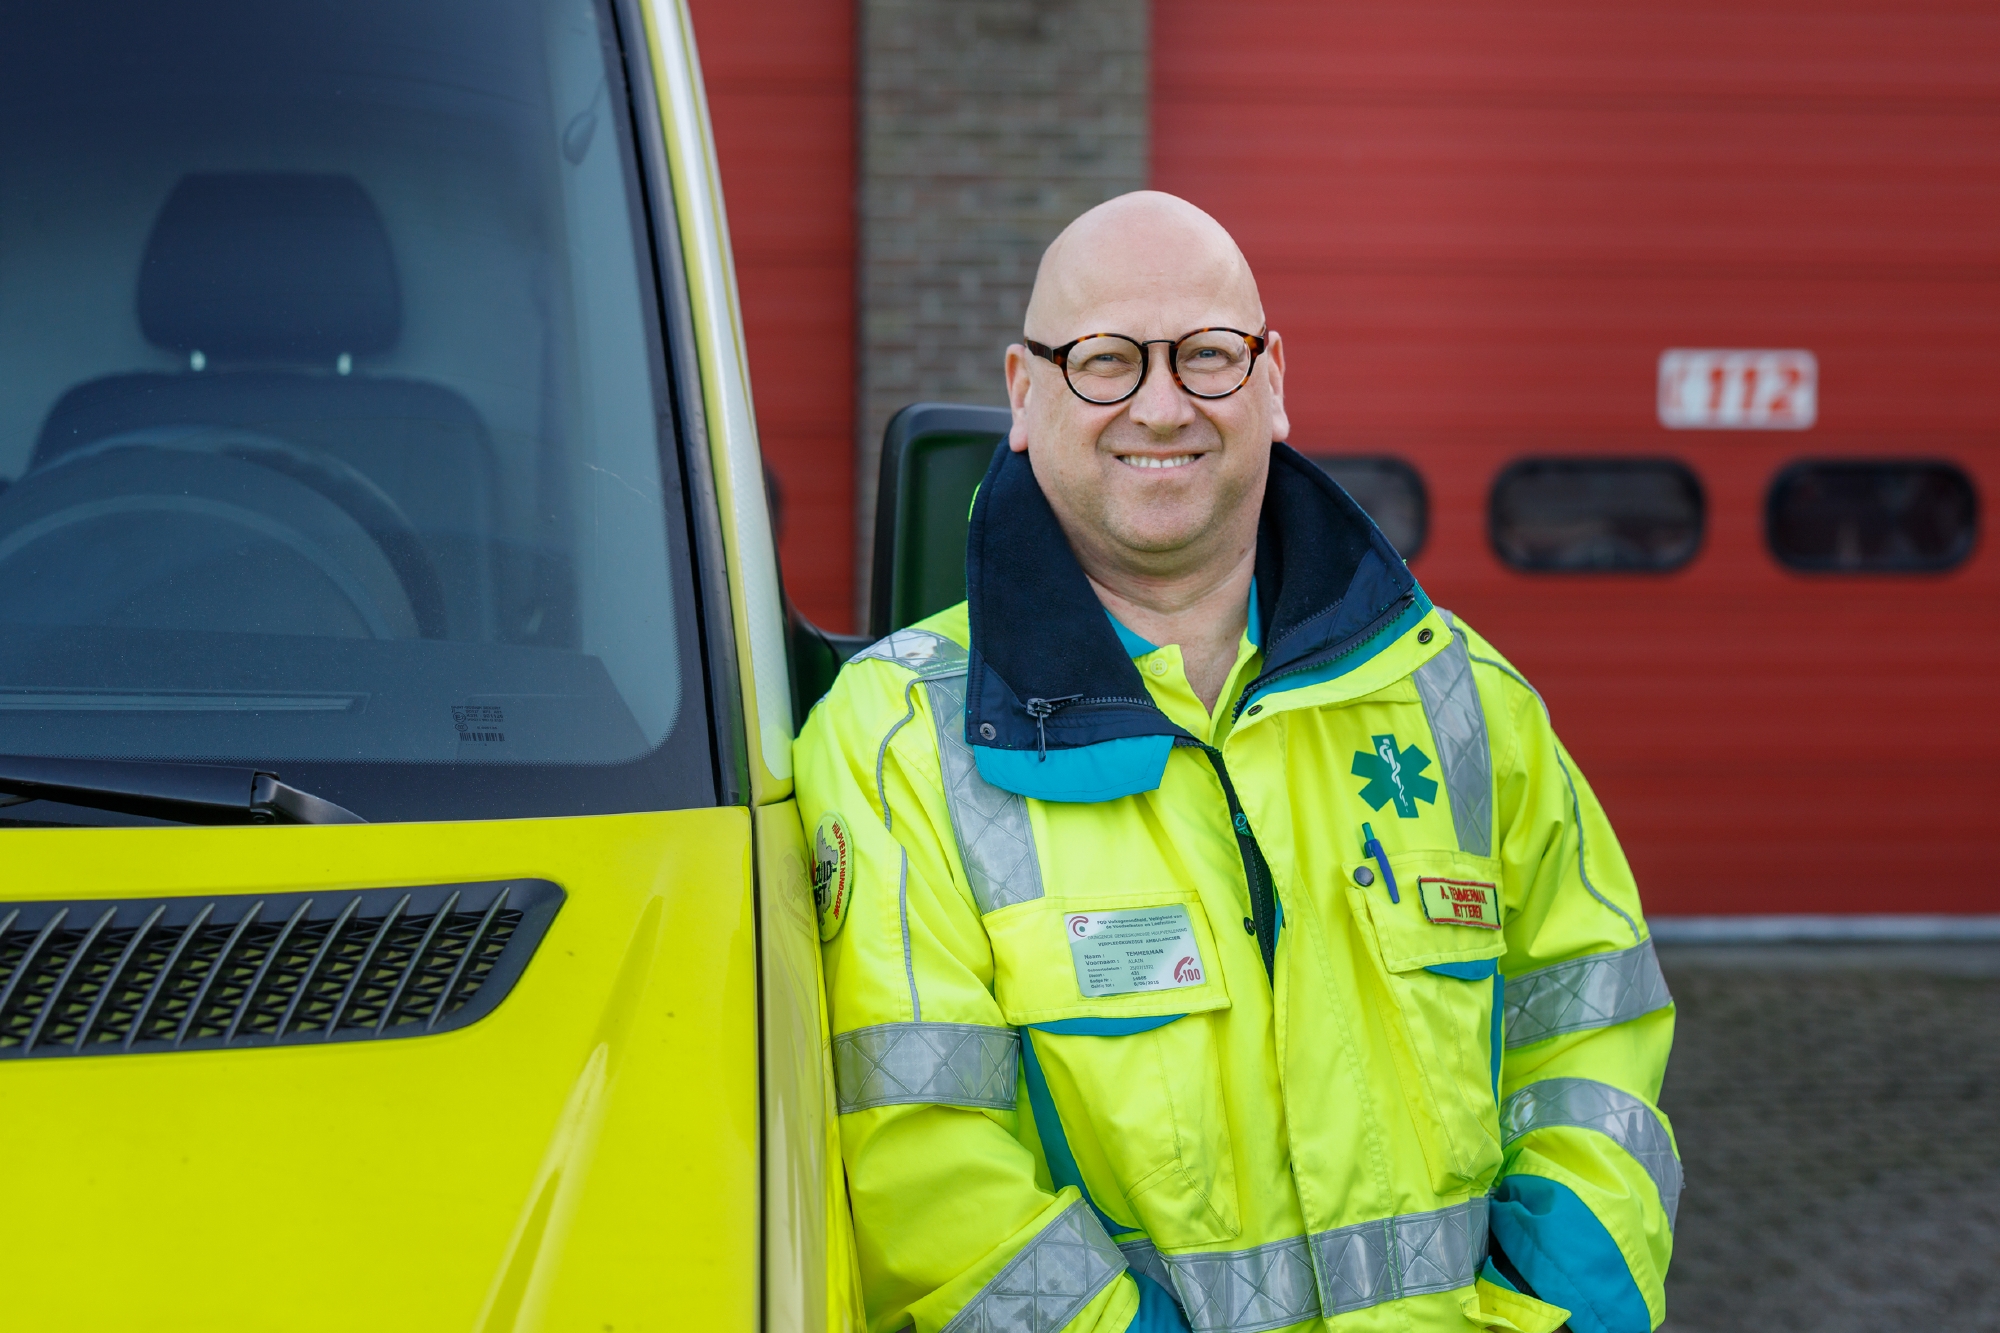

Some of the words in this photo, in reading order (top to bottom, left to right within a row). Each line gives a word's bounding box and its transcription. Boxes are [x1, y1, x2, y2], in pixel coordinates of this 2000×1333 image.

[1707, 365, 1802, 412] 112
[1126, 948, 1164, 956] TEMMERMAN
[1182, 968, 1201, 982] 100
